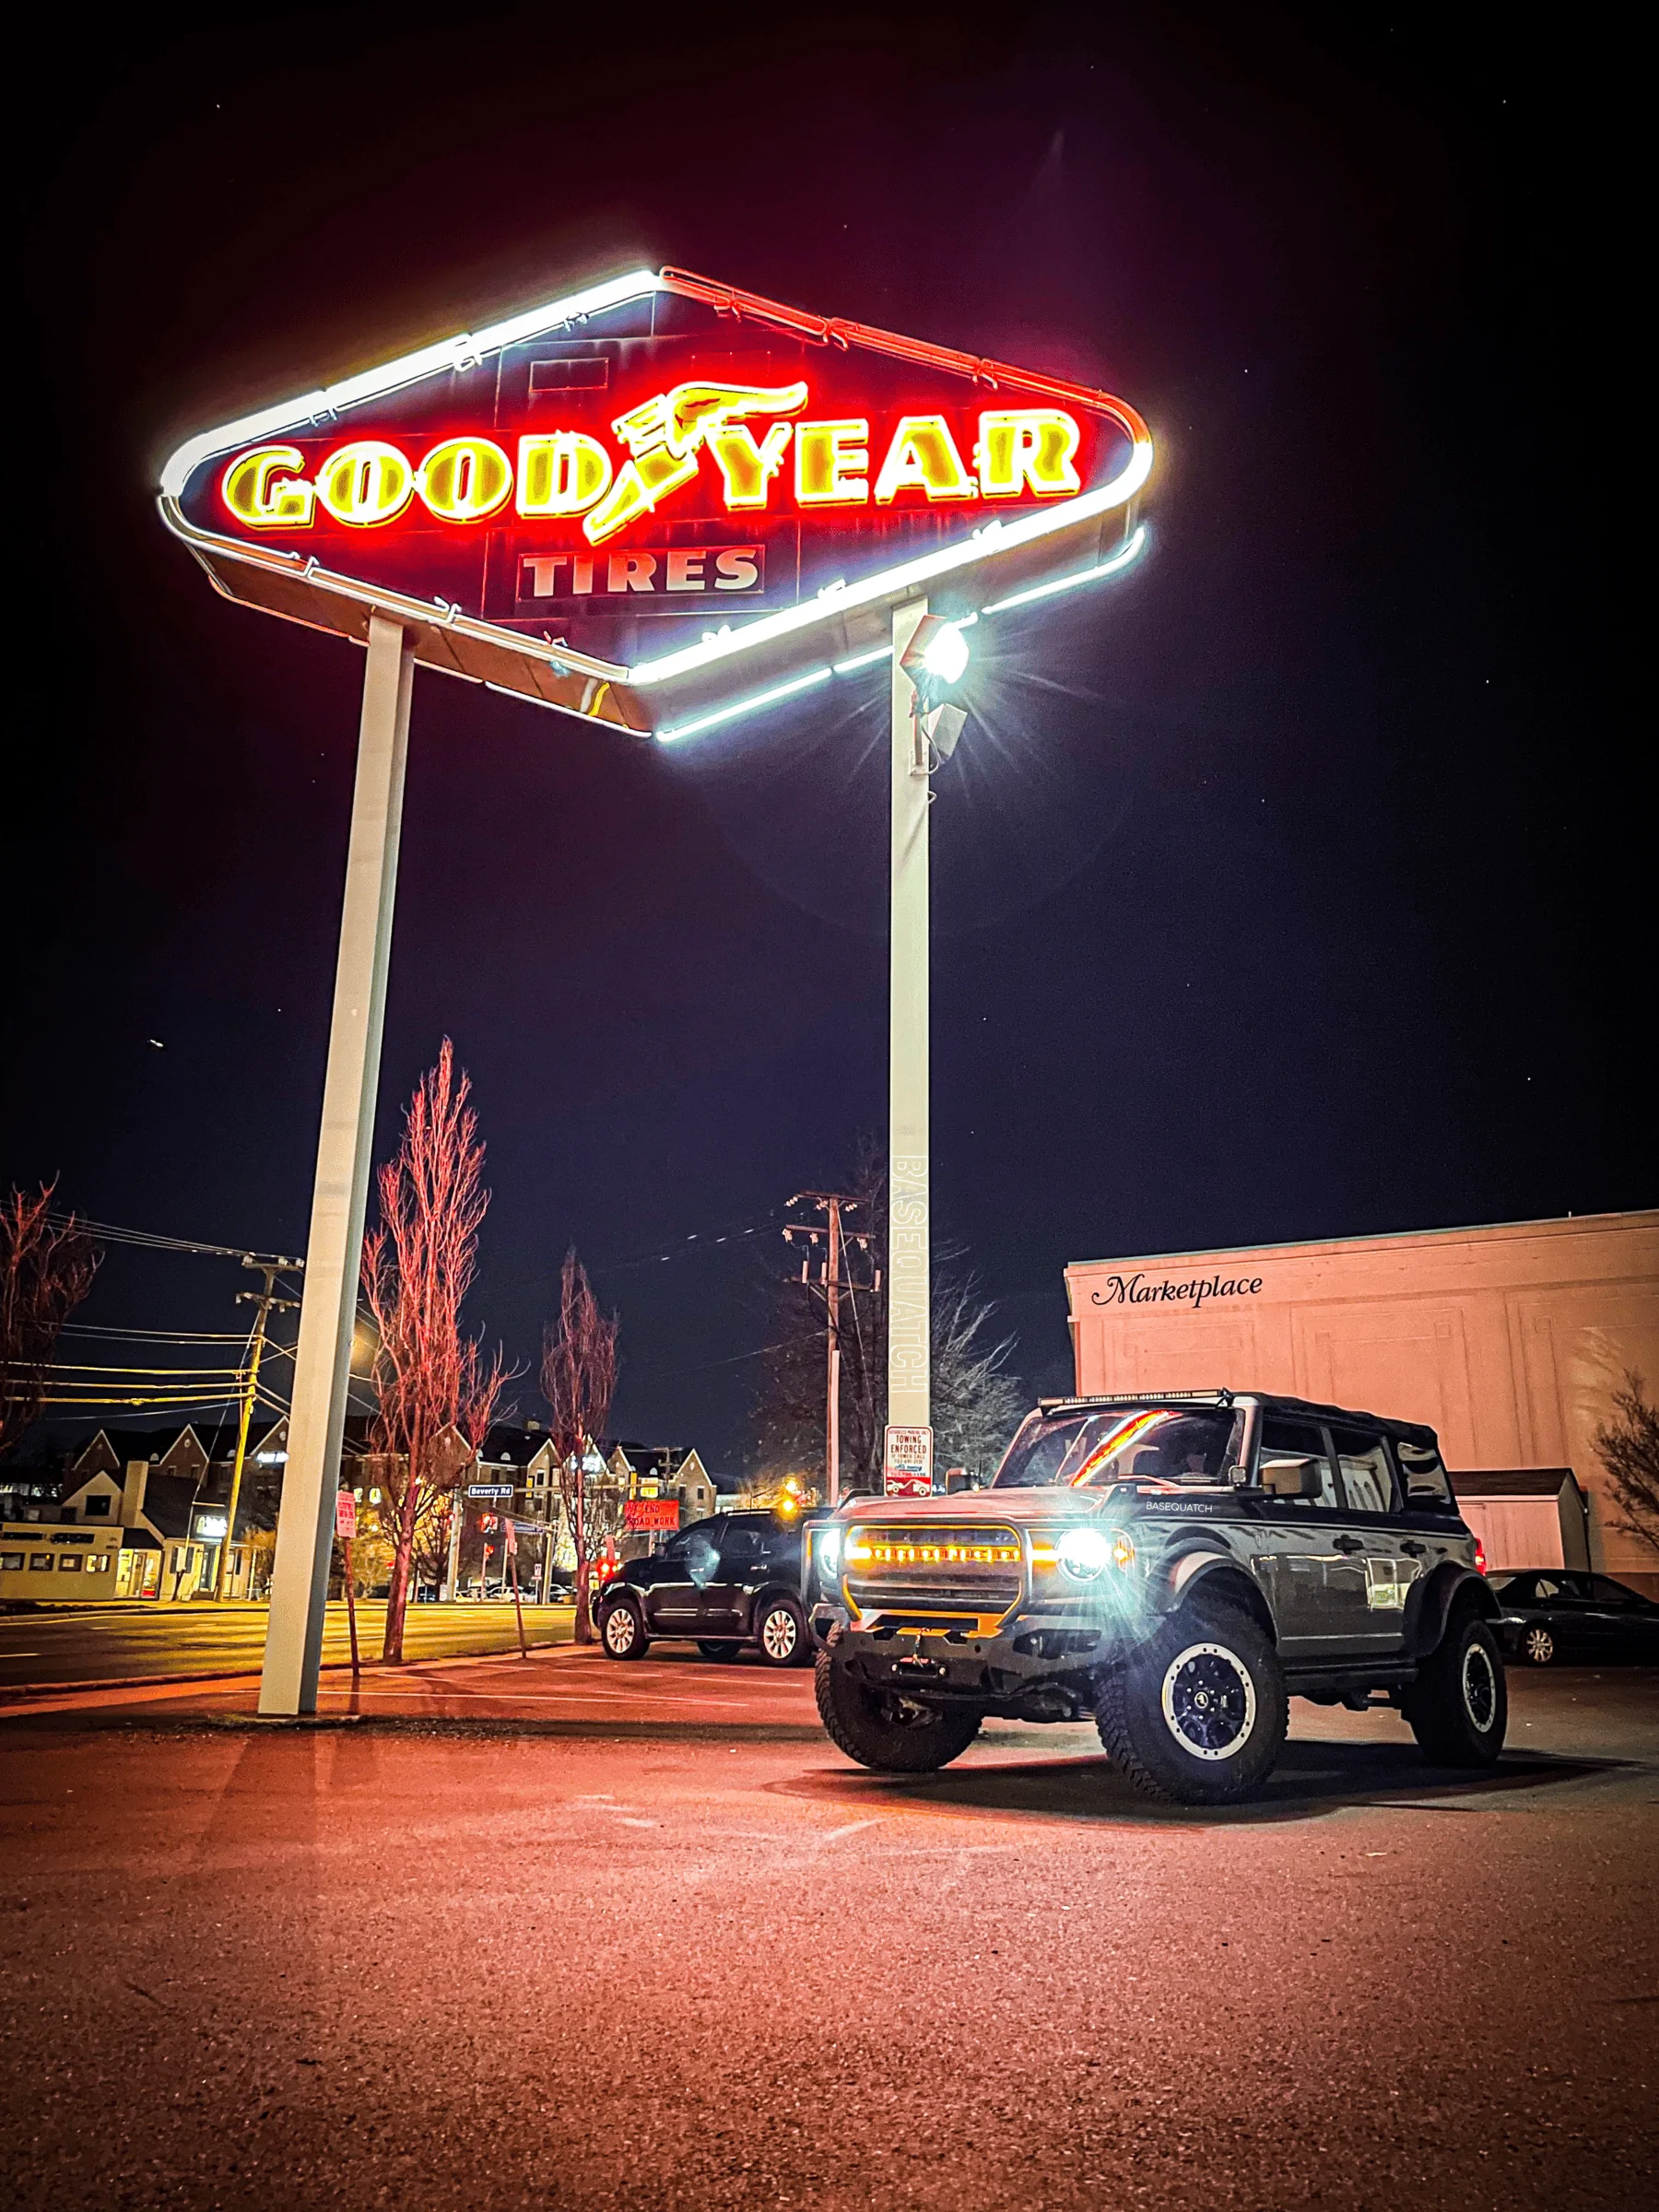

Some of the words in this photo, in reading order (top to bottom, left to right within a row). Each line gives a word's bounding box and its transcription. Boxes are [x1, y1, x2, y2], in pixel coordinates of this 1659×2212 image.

[222, 409, 1080, 530] GOODYEAR
[524, 548, 759, 597] TIRES
[1091, 1274, 1263, 1309] Marketplace
[896, 1435, 922, 1443] TOWING
[890, 1444, 926, 1453] ENFORCED
[471, 1488, 499, 1496] Beverly
[645, 1505, 660, 1513] END
[1146, 1500, 1213, 1512] BASEQUATCH
[653, 1517, 675, 1525] WORK
